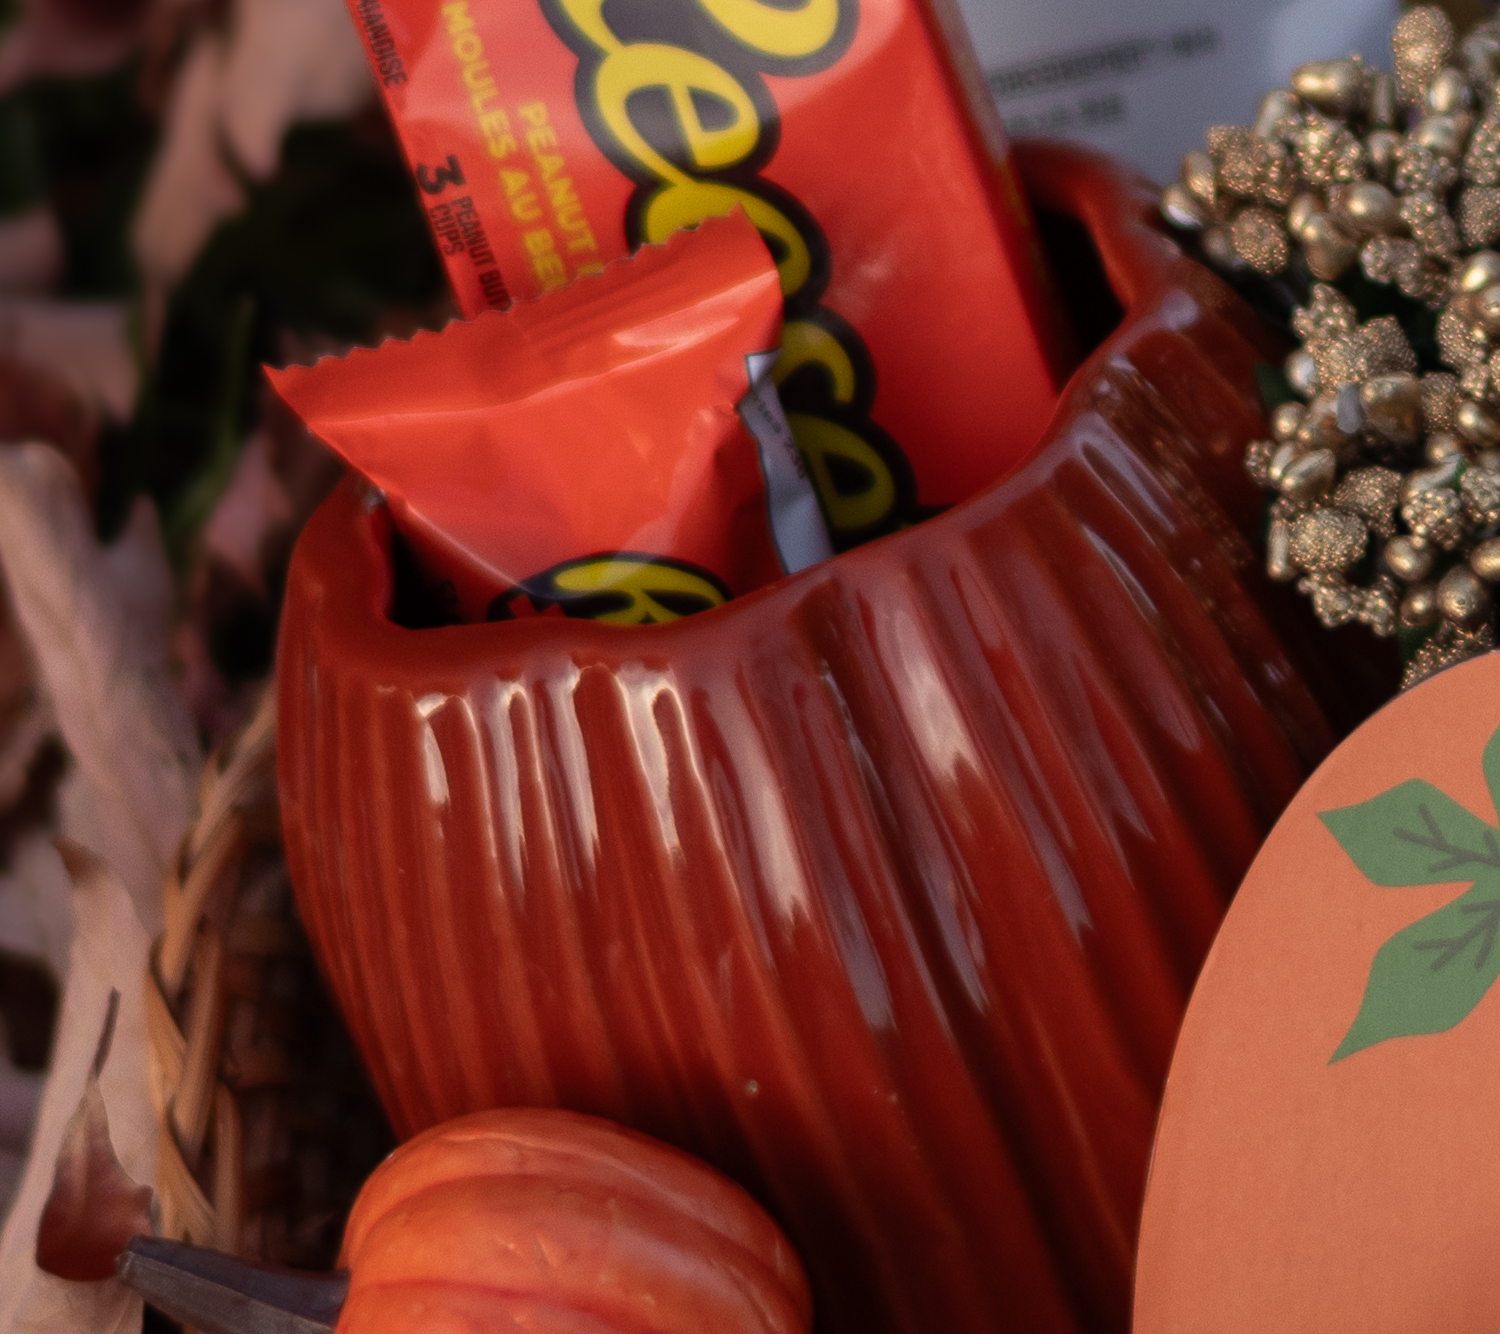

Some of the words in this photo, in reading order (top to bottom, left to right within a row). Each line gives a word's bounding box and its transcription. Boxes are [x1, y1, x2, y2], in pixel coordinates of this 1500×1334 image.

[442, 0, 518, 160] MOULES
[499, 170, 543, 223] AU
[517, 101, 598, 252] PEANUT
[417, 154, 467, 196] 3
[452, 197, 499, 268] PEANUT
[430, 204, 465, 256] CUPS
